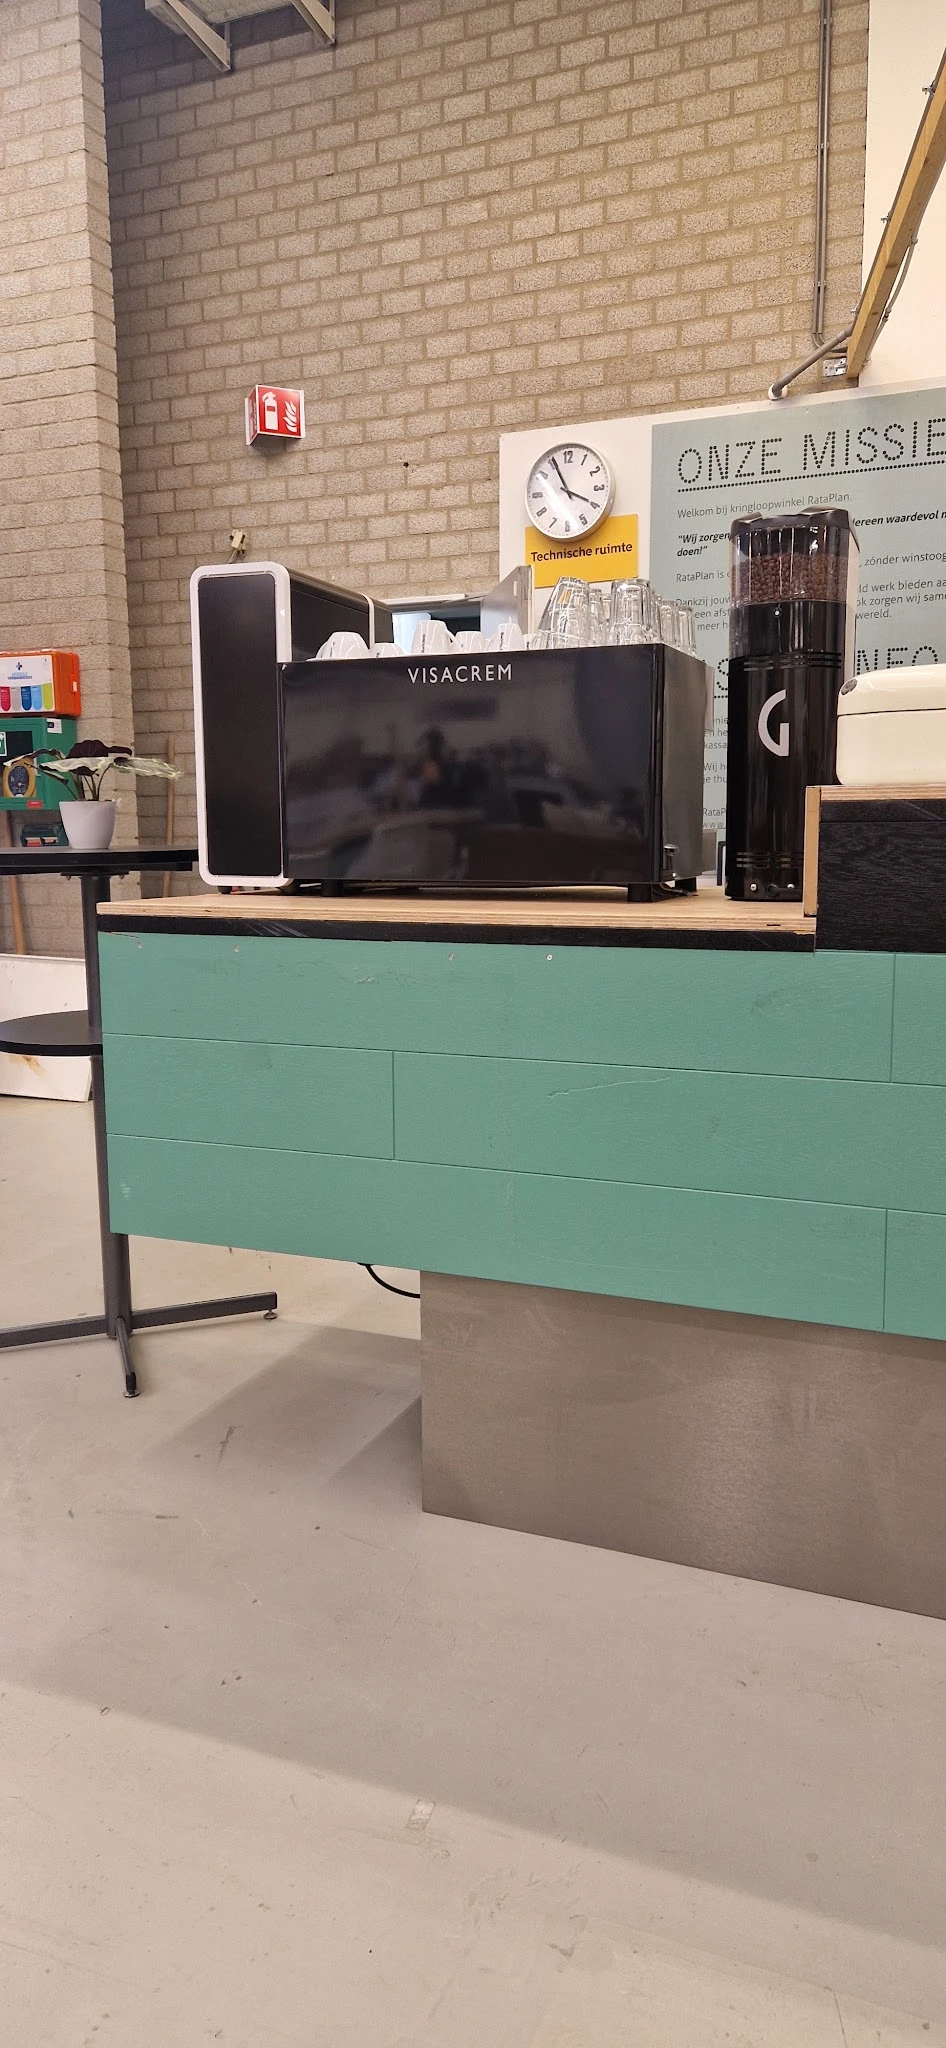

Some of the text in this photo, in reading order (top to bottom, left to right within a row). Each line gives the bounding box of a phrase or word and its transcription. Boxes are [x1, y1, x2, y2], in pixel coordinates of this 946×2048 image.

[562, 450, 573, 464] 12
[678, 418, 946, 484] ONZE MISSIE
[581, 453, 588, 466] 1
[589, 465, 601, 477] 2
[593, 484, 605, 492] 3
[677, 492, 852, 518] Welkom bij kringloopwinkel RataPlan.
[549, 517, 558, 528] 7
[579, 513, 588, 526] 5
[853, 517, 883, 527] ereen
[886, 510, 939, 524] waardevol
[564, 520, 571, 532] 6
[699, 532, 730, 543] zorgen
[530, 542, 633, 562] Technische ruimte
[864, 555, 899, 566] zónder
[676, 571, 714, 582] RataPlan
[717, 570, 724, 579] is
[871, 582, 895, 592] werk
[898, 579, 933, 590] bieden
[869, 596, 903, 607] zorgen
[906, 592, 921, 604] wij
[923, 593, 946, 601] sam
[695, 610, 711, 619] een
[856, 608, 892, 619] wereld.
[697, 622, 720, 631] meer
[407, 663, 513, 683] VISACREM
[758, 689, 789, 757] G
